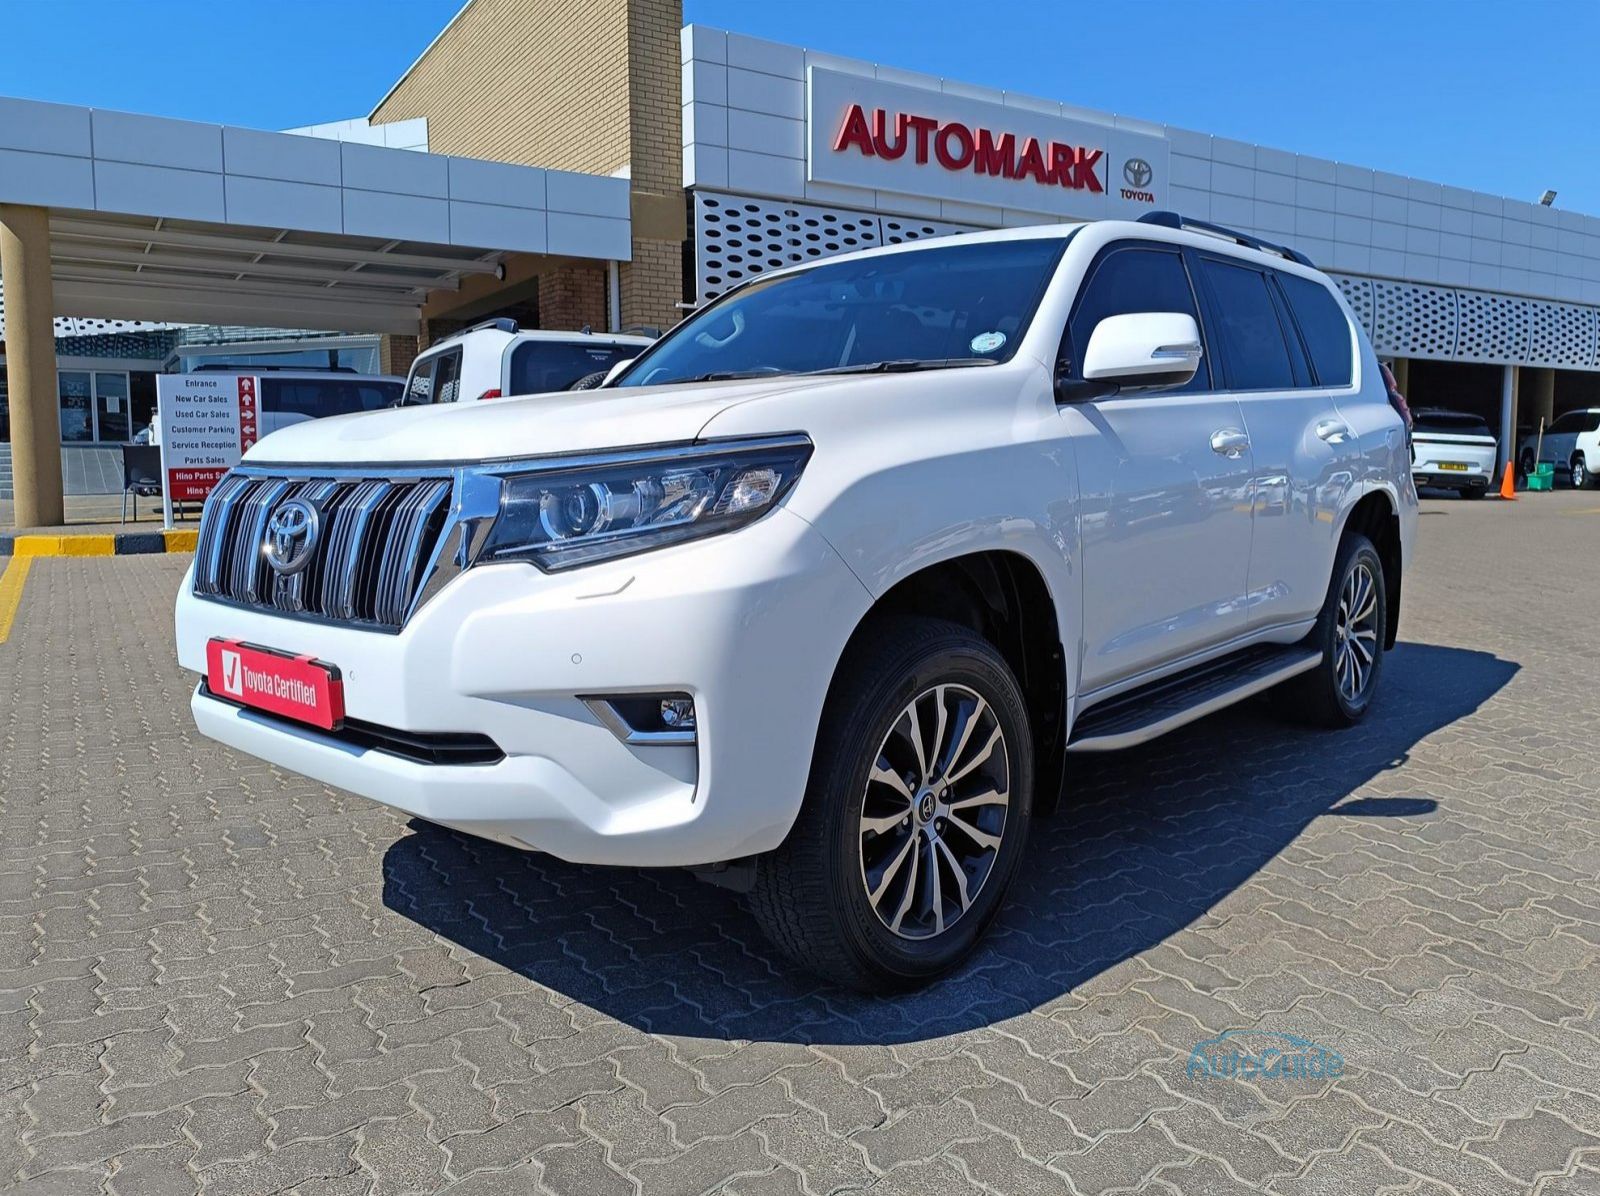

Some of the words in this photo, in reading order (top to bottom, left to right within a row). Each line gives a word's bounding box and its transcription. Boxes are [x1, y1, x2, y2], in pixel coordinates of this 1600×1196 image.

[833, 103, 1104, 193] AUTOMARK
[1120, 188, 1154, 202] TOYOTA
[185, 379, 217, 388] Entrance
[175, 394, 192, 403] New
[193, 394, 206, 403] Car
[208, 394, 228, 404] Sales
[175, 410, 194, 419] Used
[195, 410, 208, 419] Car
[210, 410, 230, 419] Sales
[171, 425, 206, 434] Customer
[208, 425, 235, 435] Parking
[171, 441, 199, 450] Service
[201, 441, 237, 450] Reception
[184, 456, 203, 464] Parts
[206, 456, 225, 464] Sales
[176, 472, 193, 480] Hino
[194, 471, 214, 480] Parts
[186, 486, 204, 496] Hino
[243, 666, 273, 694] Toyota
[274, 674, 317, 707] Certified
